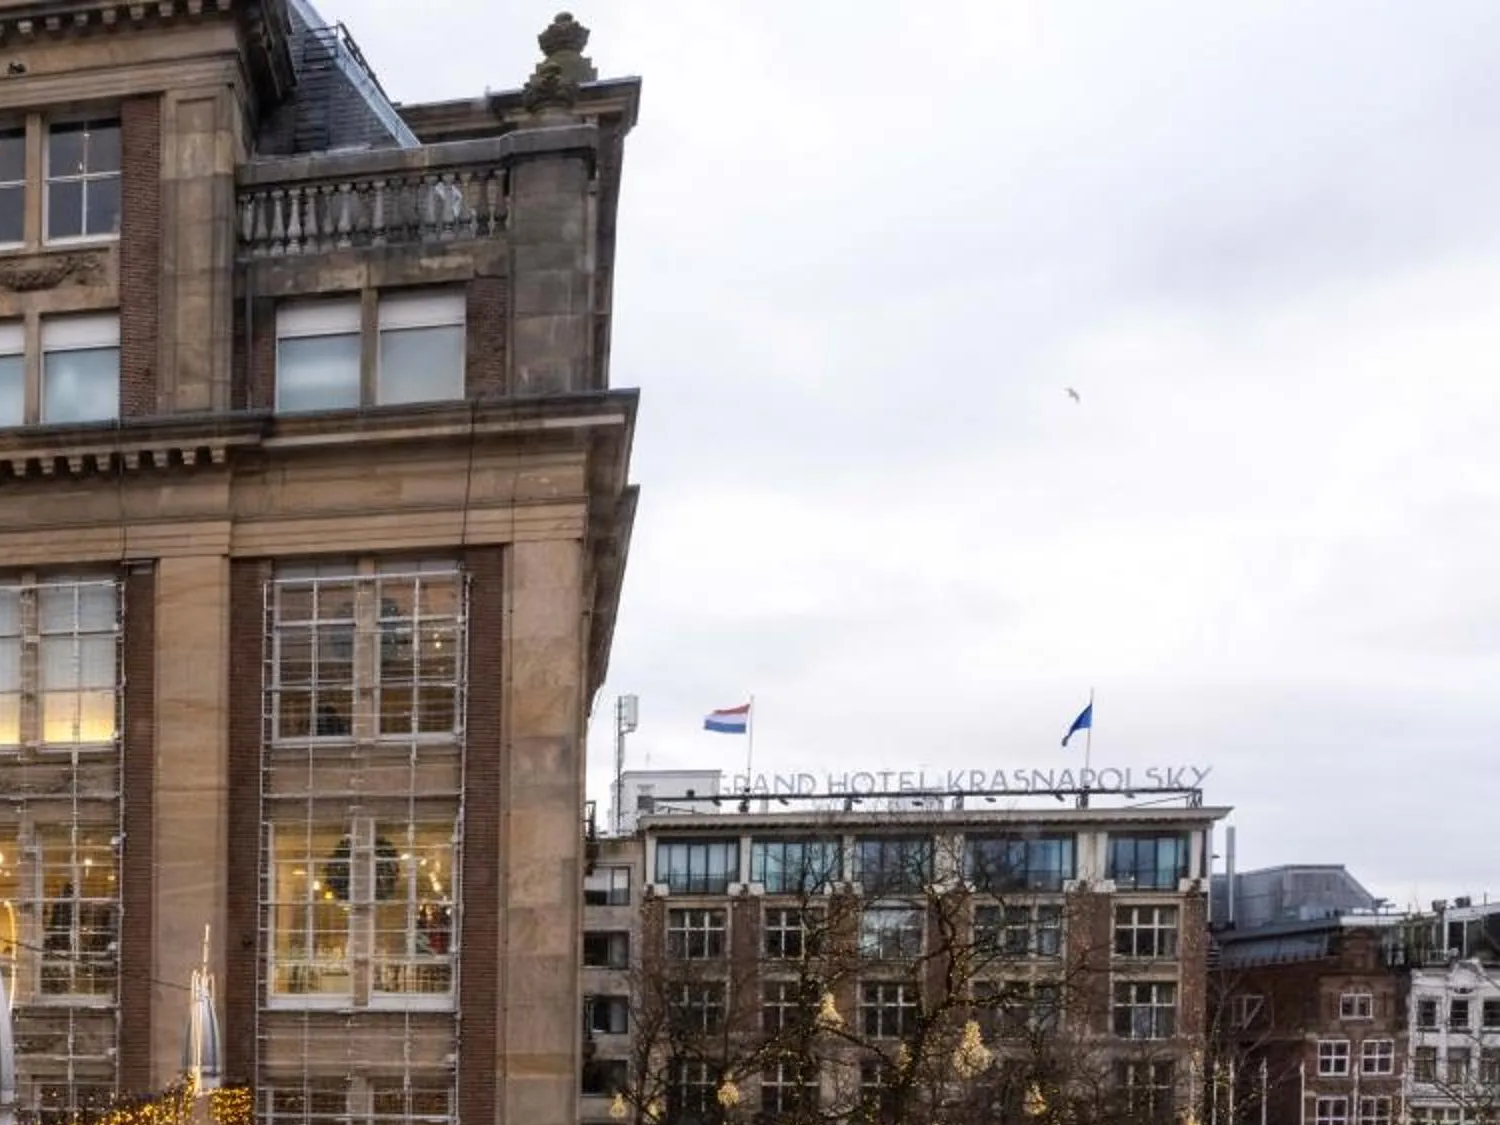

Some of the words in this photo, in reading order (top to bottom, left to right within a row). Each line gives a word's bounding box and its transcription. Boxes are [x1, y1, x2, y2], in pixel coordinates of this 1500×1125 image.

[720, 773, 816, 795] GRAND
[828, 770, 942, 793] HOTEL
[947, 766, 1211, 790] KRASNAPOLSKY
